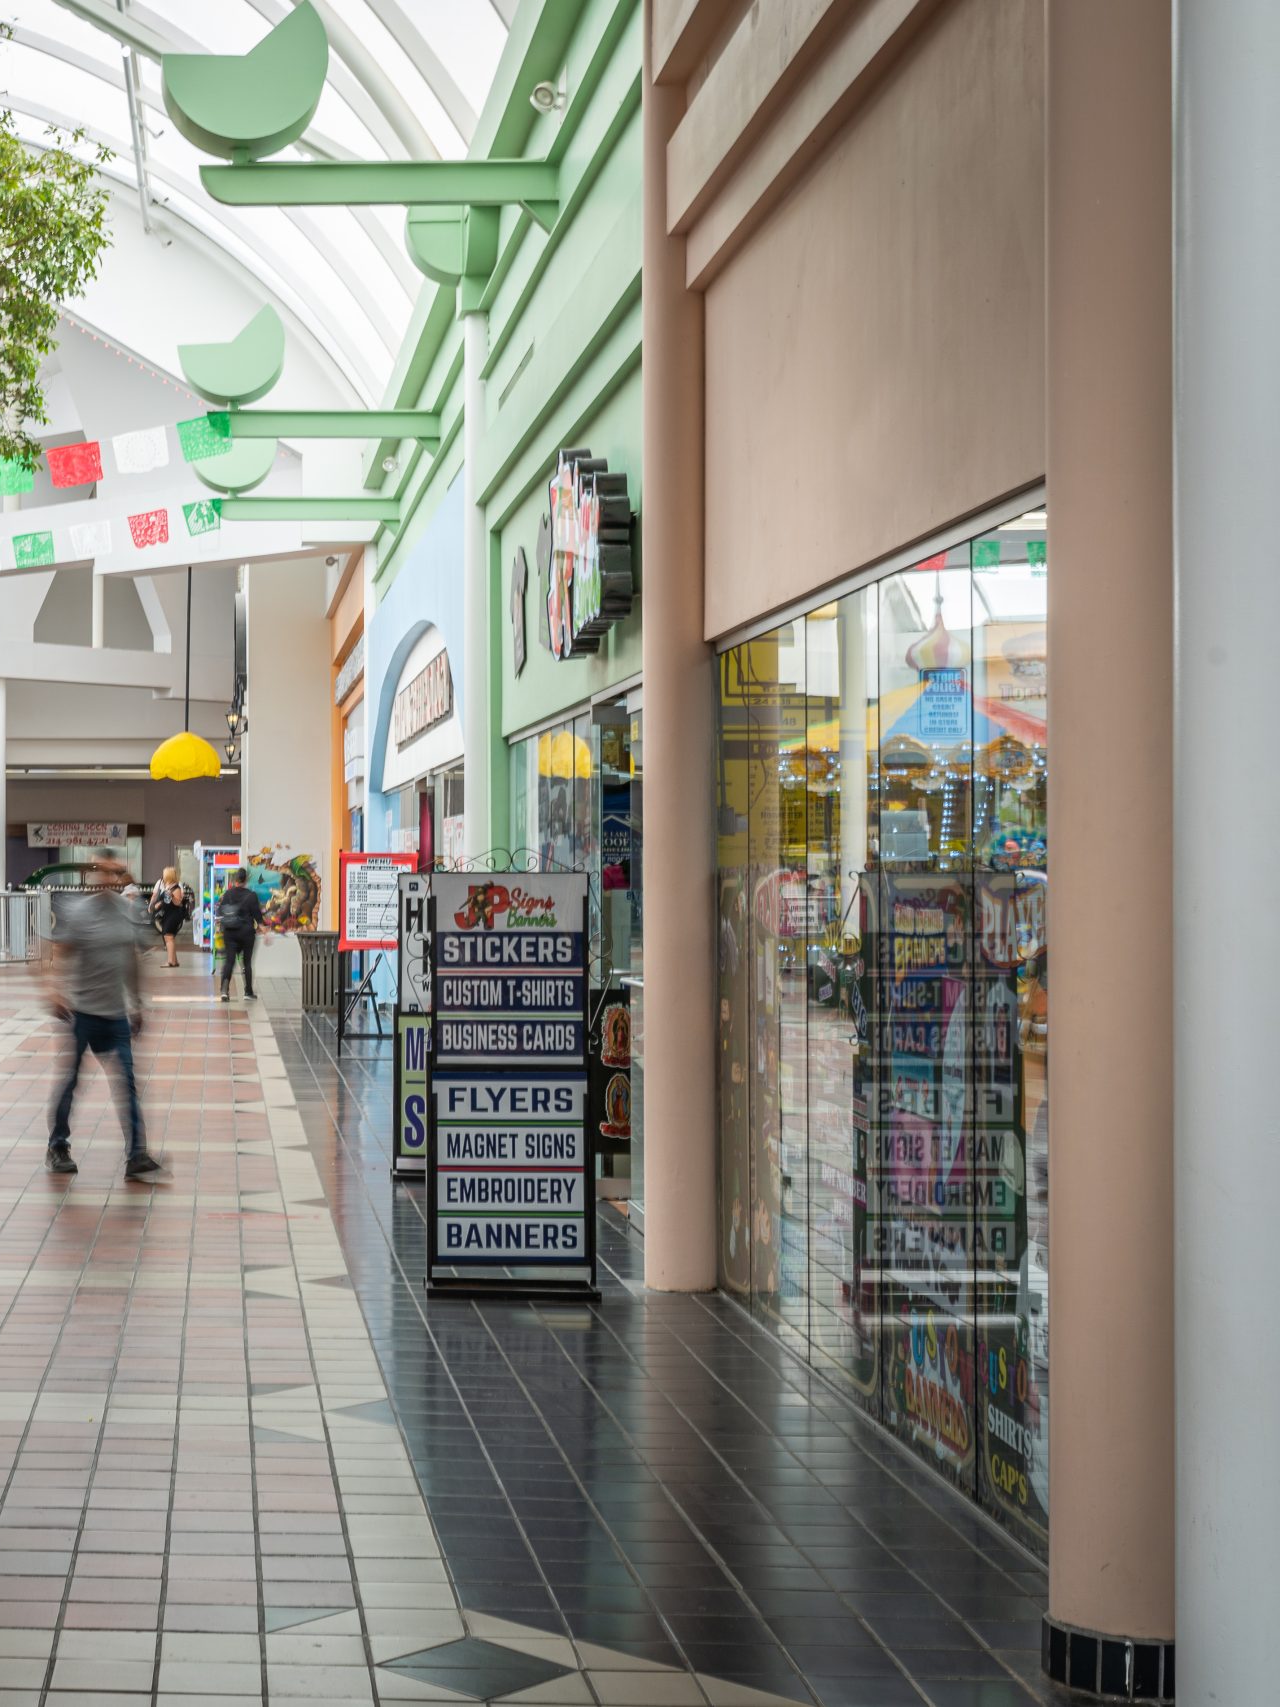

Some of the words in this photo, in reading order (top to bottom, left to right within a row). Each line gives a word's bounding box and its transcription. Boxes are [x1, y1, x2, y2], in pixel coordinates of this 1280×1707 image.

[368, 858, 391, 866] MENU
[510, 887, 556, 917] Signs
[506, 906, 558, 929] Banners
[443, 936, 573, 963] STICKERS
[443, 980, 502, 1006] CUSTOM
[507, 980, 574, 1006] T-SHIRTS
[442, 1024, 518, 1051] BUSINESS
[522, 1024, 575, 1051] CARDS
[448, 1087, 573, 1113] FLYERS
[446, 1133, 519, 1159] MAGNET
[525, 1133, 576, 1159] SIGNS
[446, 1178, 577, 1204] EMBROIDERY
[446, 1223, 578, 1249] BANNERS
[987, 1402, 1033, 1462] SHIRTS
[991, 1454, 1028, 1505] CAP'S
